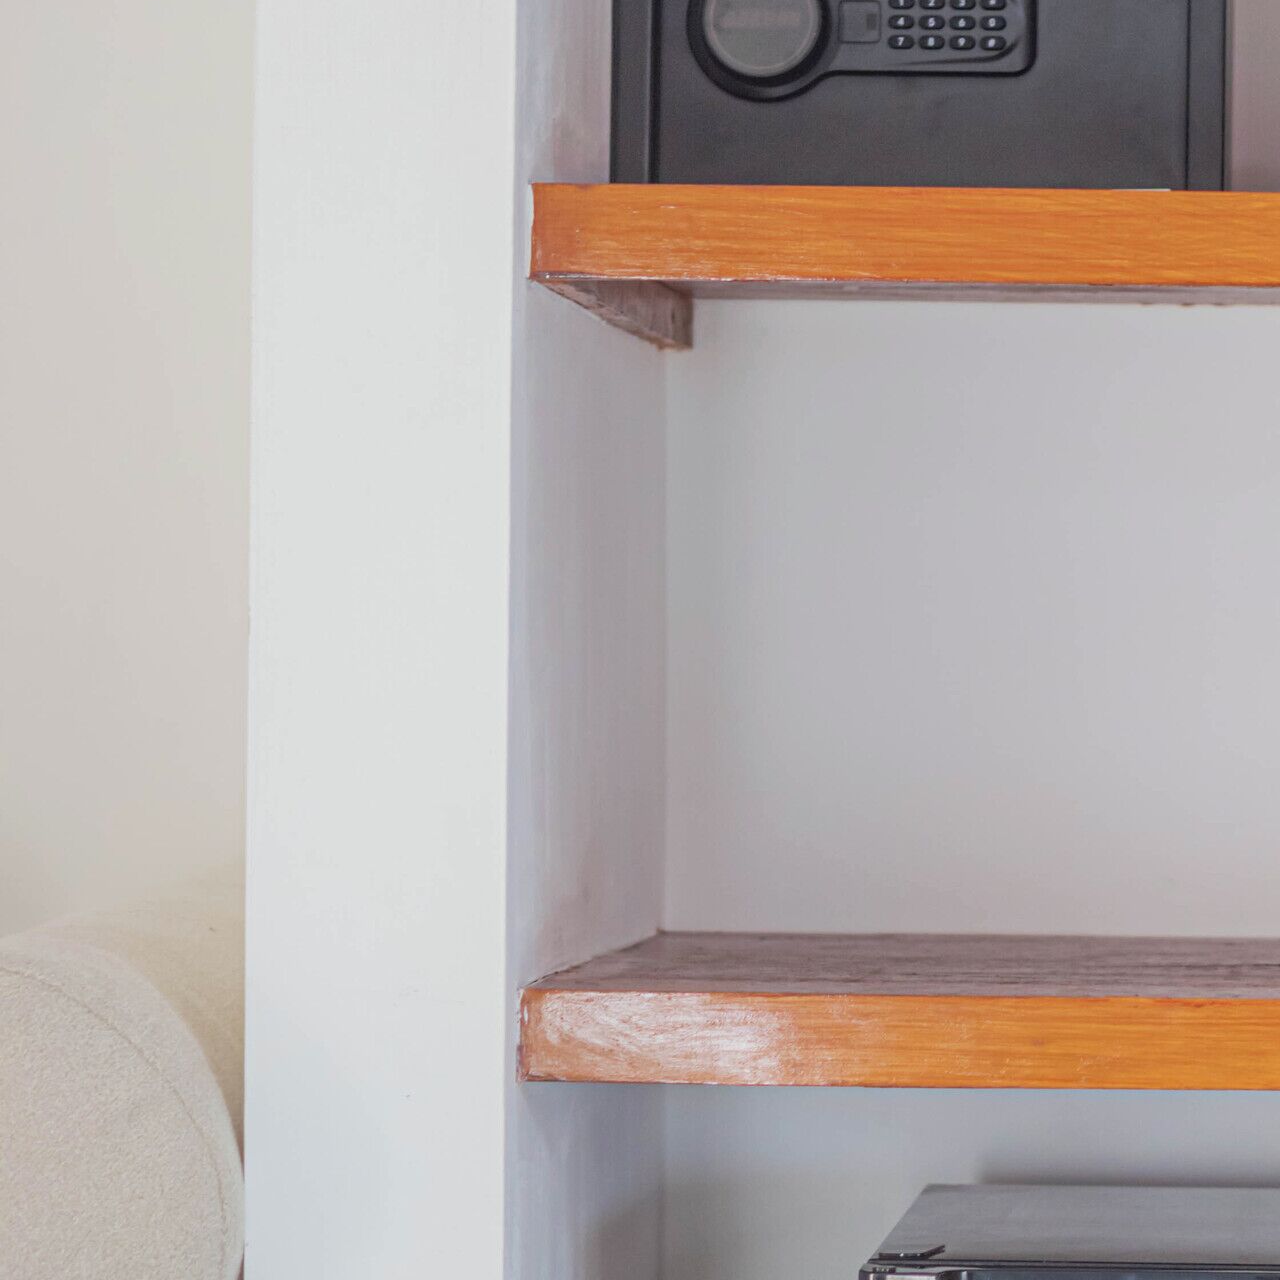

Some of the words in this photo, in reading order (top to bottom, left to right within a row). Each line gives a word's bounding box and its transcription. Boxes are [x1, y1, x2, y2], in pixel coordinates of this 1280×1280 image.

[897, 17, 905, 27] 4
[928, 17, 935, 28] 5
[959, 18, 966, 28] 6
[898, 36, 905, 46] 7
[927, 37, 935, 47] 8
[958, 37, 966, 47] 9
